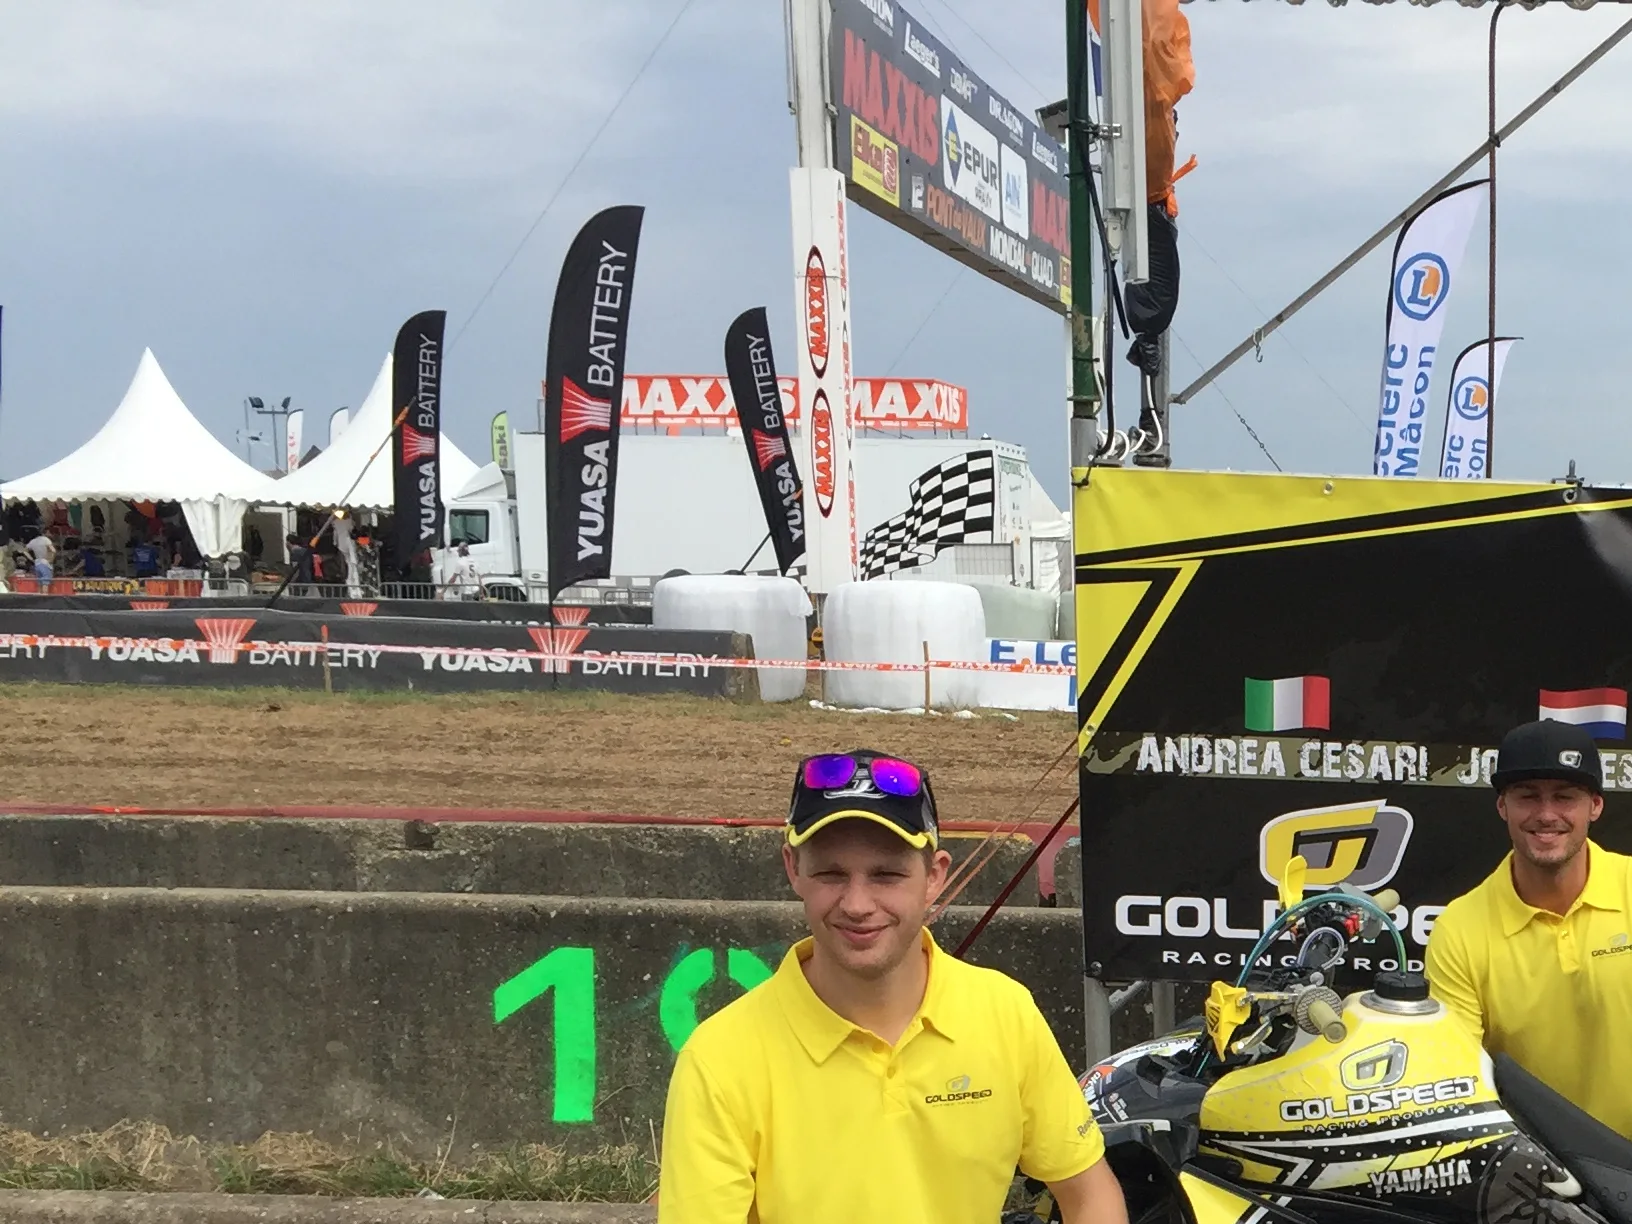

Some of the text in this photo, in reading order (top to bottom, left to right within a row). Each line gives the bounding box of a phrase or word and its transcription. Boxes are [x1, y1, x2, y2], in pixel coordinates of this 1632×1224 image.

[843, 28, 938, 166] MAXXIS
[964, 141, 998, 190] EPUR
[1033, 178, 1070, 257] MAX
[990, 225, 1027, 274] MONDIAL
[806, 267, 828, 359] MAXXIS
[578, 240, 627, 562] YUASA BATTERY
[621, 377, 797, 416] MAXXS
[1374, 343, 1408, 477] clerc
[418, 333, 438, 541] YUASA BATTERY
[747, 333, 803, 542] YUASA BATTERY
[814, 408, 833, 498] MAXXIS
[85, 636, 200, 664] YUASA
[249, 640, 382, 669] BATTERY
[418, 648, 719, 678] YUASA BATTERY
[1023, 663, 1077, 676] MAXX
[1137, 735, 1429, 782] ANDREA CESARI
[1162, 950, 1299, 968] RACING
[925, 1088, 992, 1105] GOLDSPEED
[1279, 1076, 1476, 1122] GOLDSPEED
[1303, 1102, 1467, 1134] RACING PRODUCTS
[1368, 1159, 1473, 1196] YAMAHA
